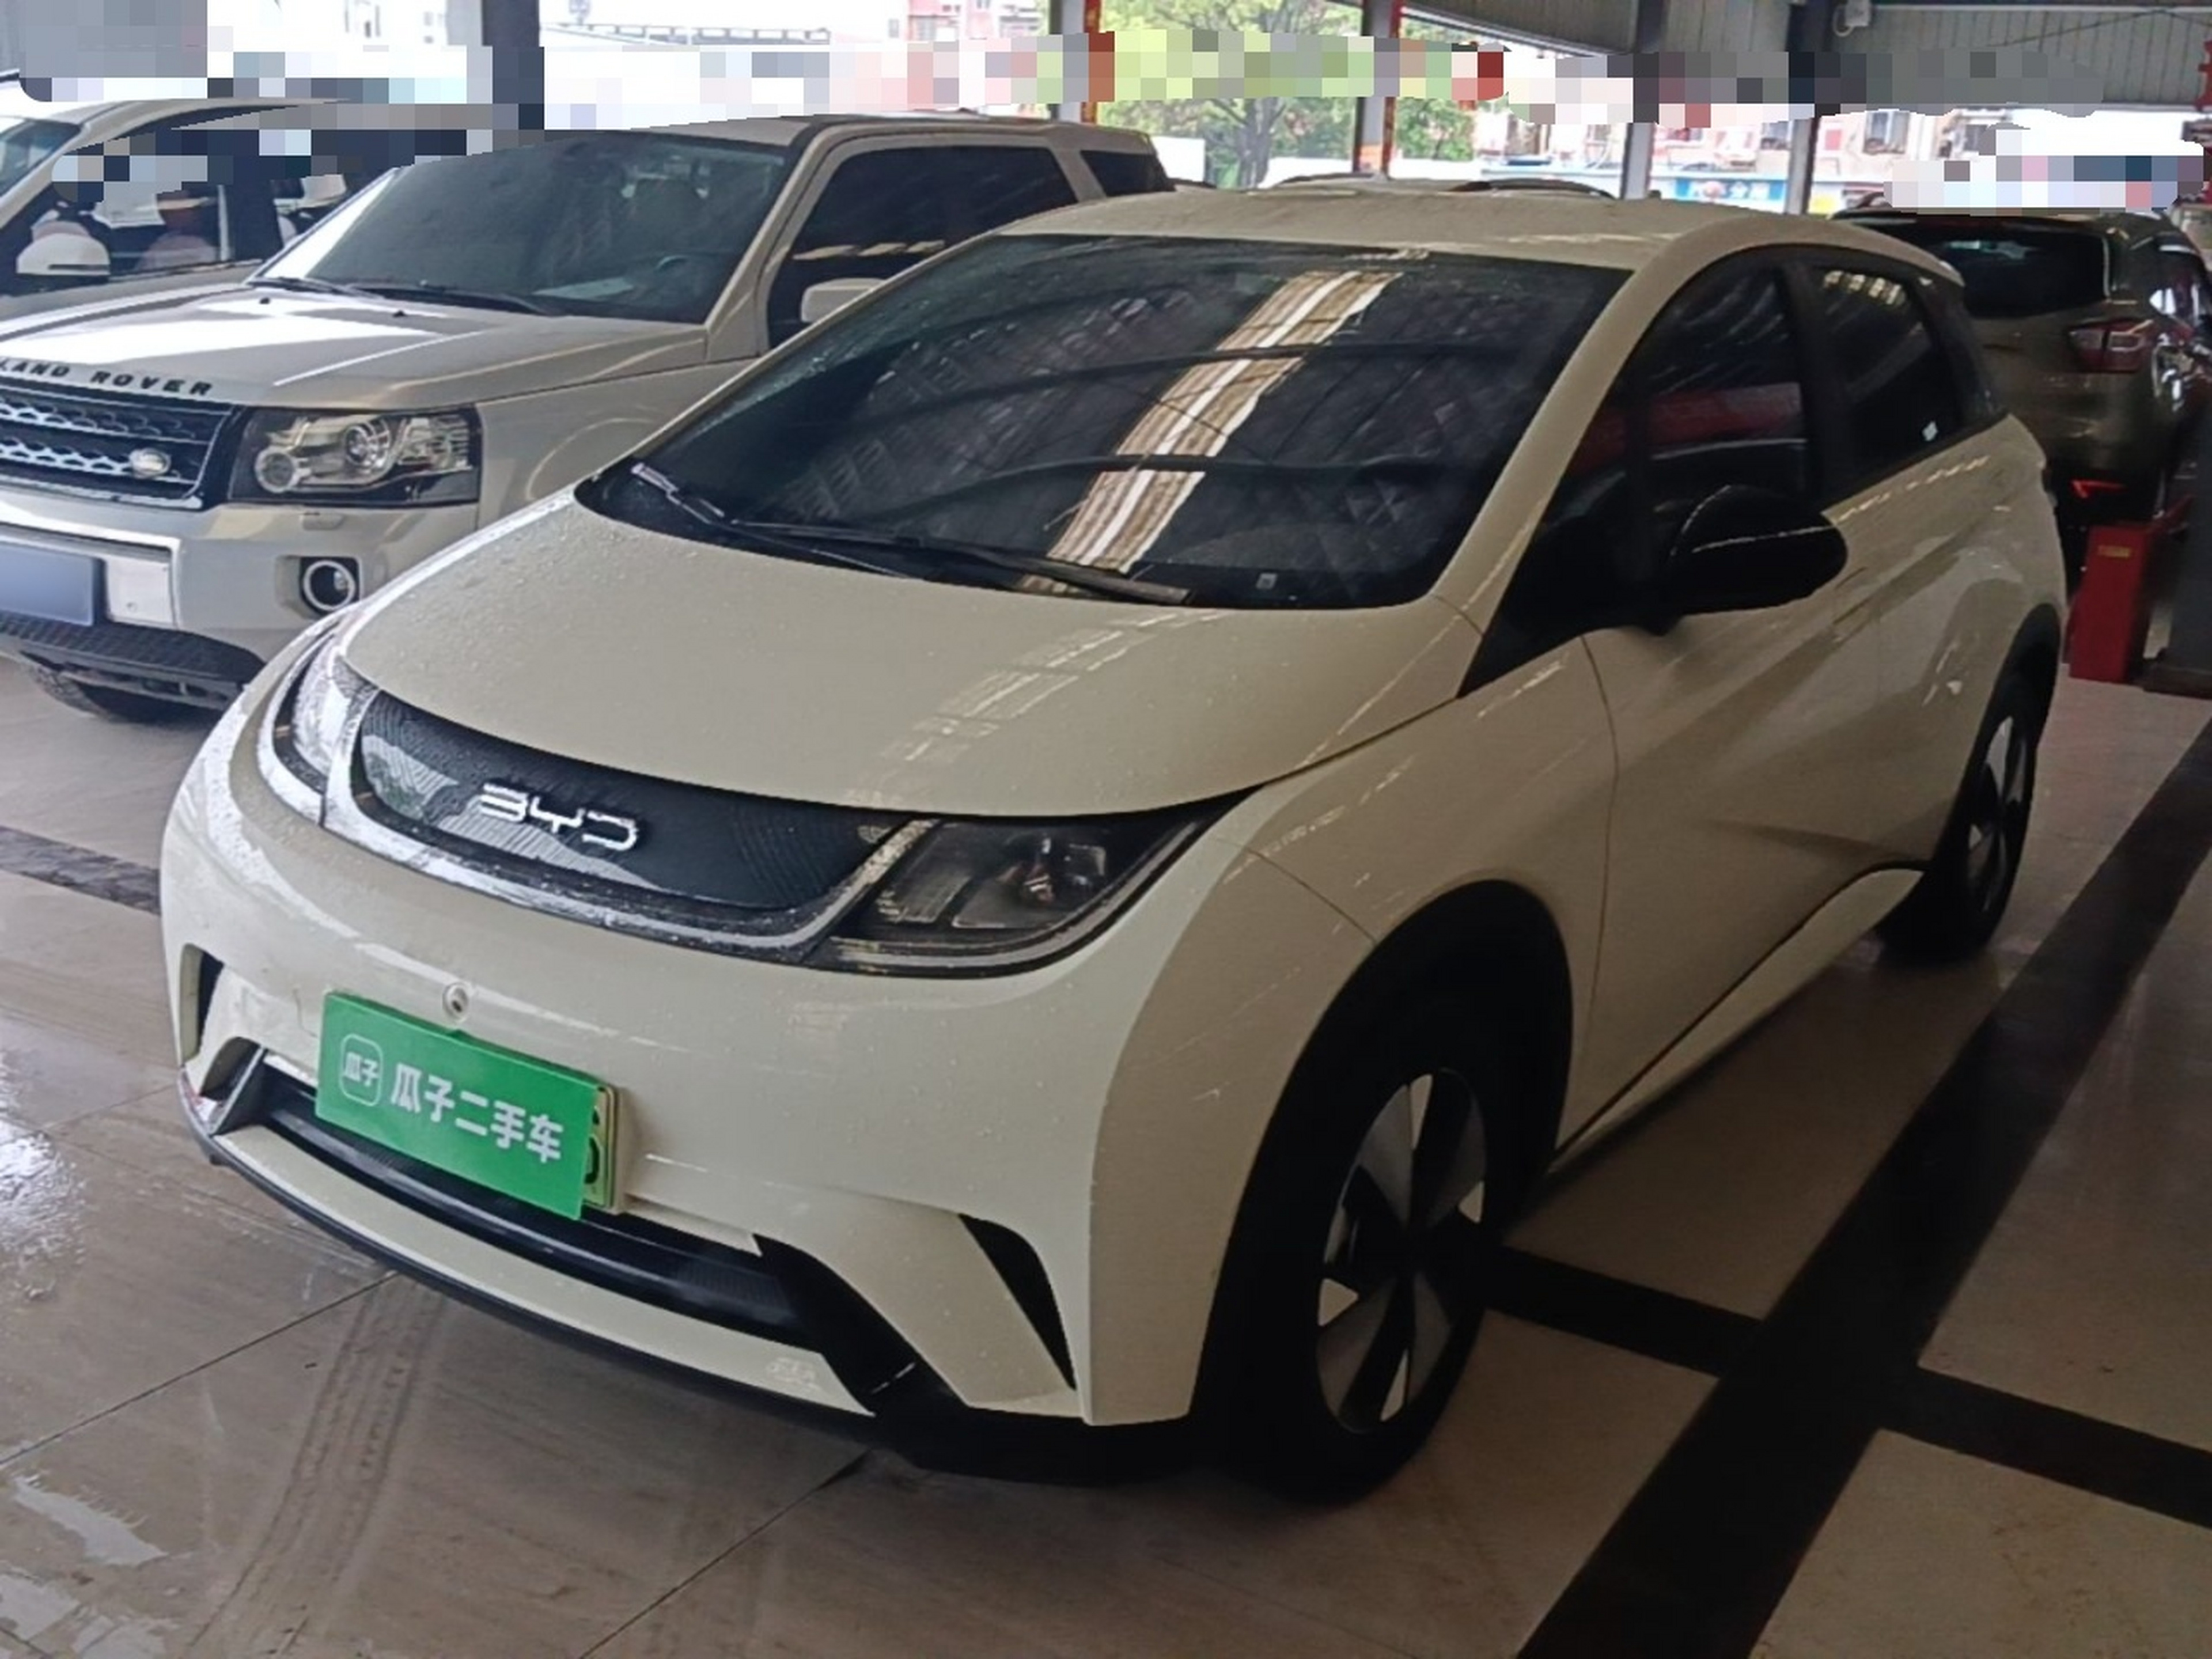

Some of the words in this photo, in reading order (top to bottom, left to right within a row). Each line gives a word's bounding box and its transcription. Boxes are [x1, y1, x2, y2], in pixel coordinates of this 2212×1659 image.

[0, 358, 70, 377] LAND
[90, 371, 213, 395] ROVER
[480, 783, 638, 851] BYD
[391, 1063, 563, 1163] 瓜子二手车
